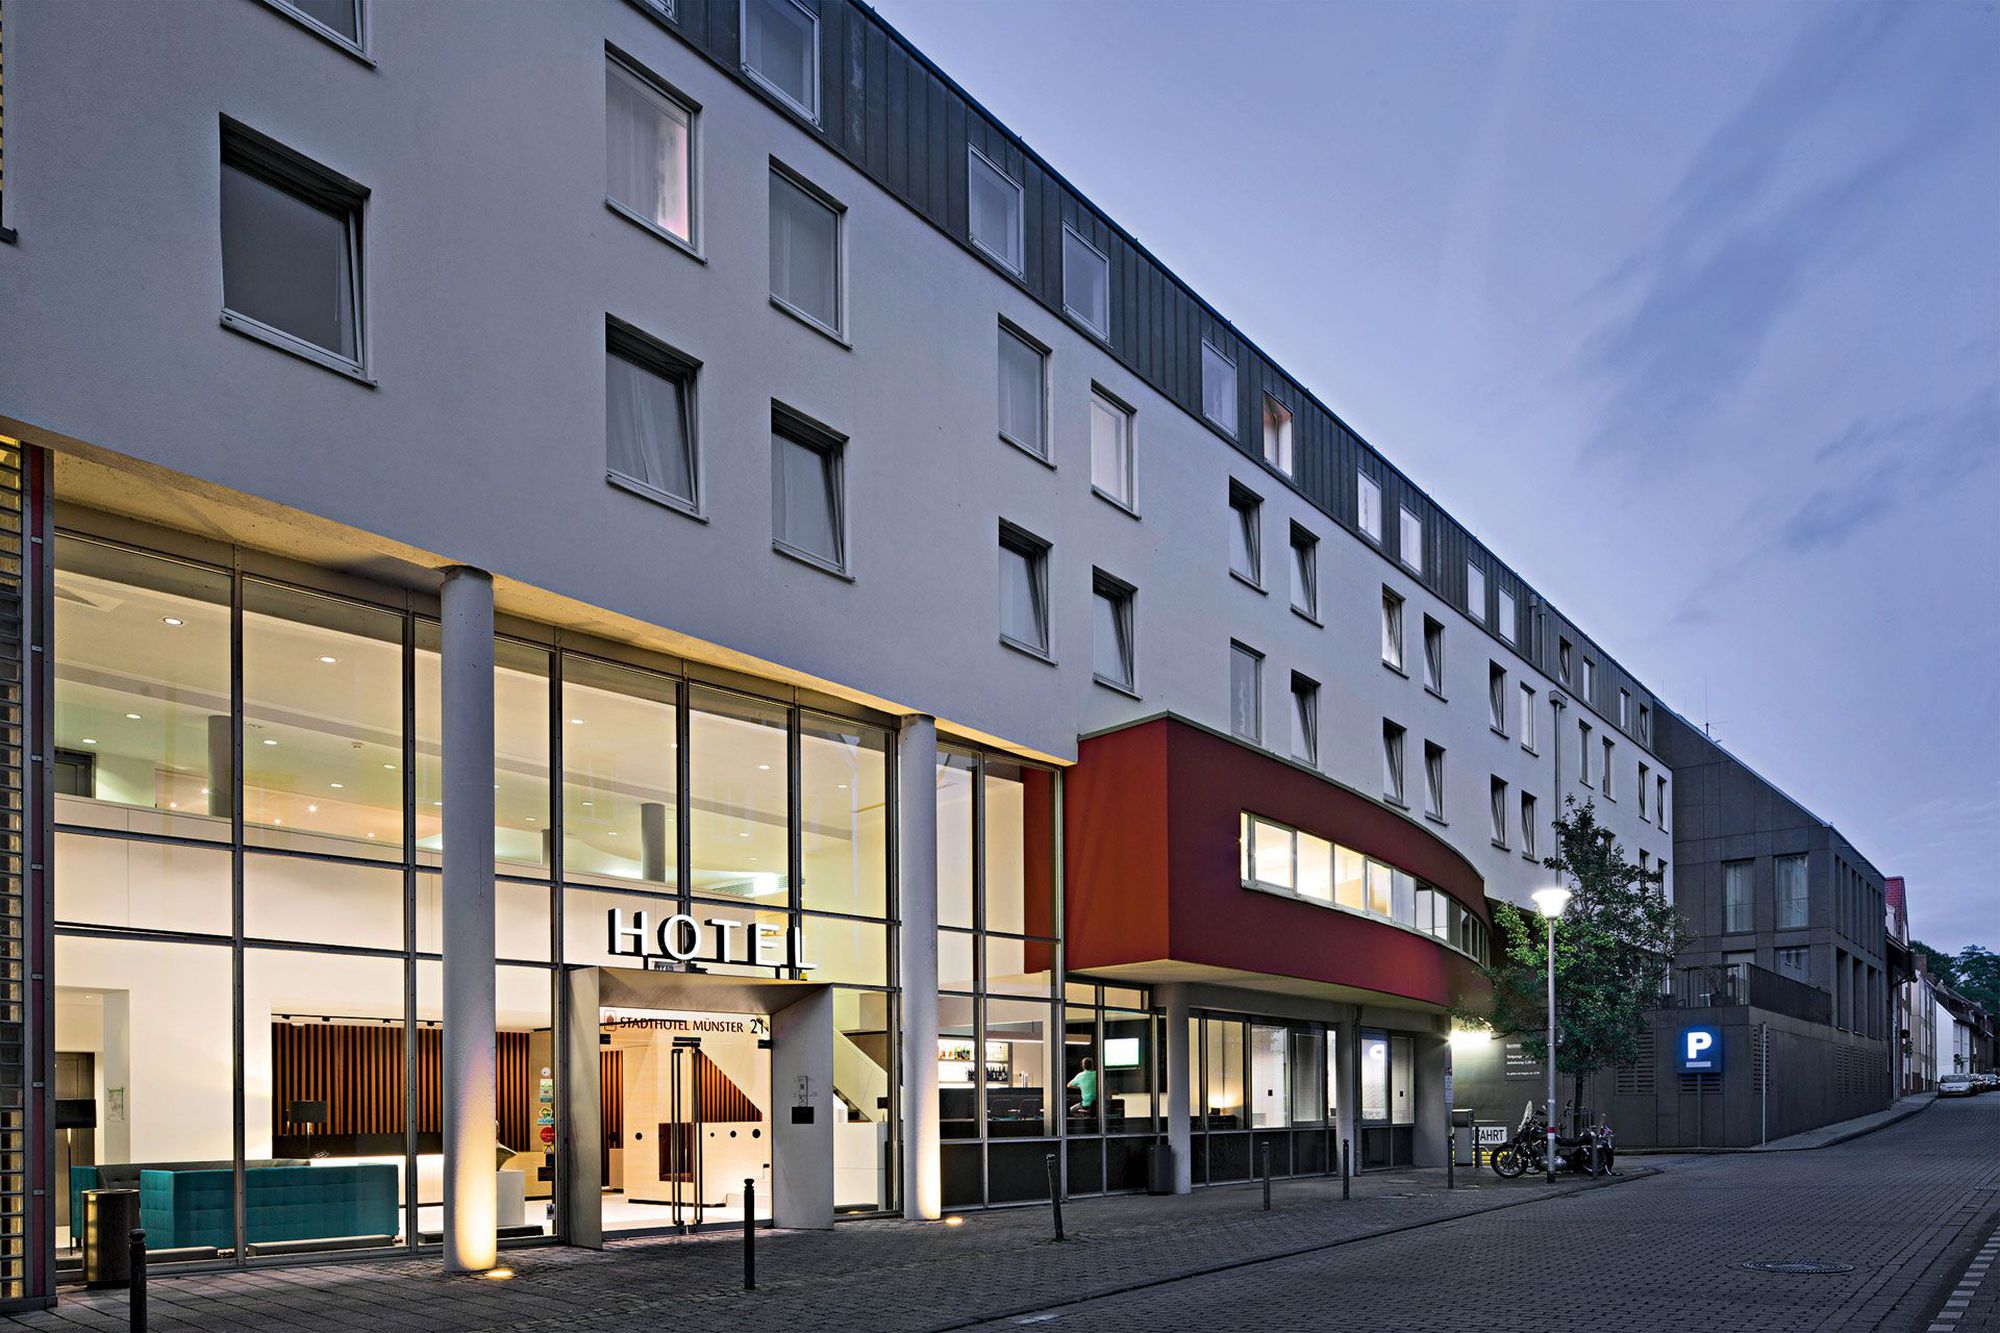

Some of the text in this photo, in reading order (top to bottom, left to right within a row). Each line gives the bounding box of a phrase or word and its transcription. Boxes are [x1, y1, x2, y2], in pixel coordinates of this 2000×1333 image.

[608, 908, 816, 969] HOTEL
[620, 1016, 690, 1031] STADTHOTEL
[692, 1017, 744, 1033] MÜNSTER
[1687, 1031, 1712, 1059] P
[1475, 1129, 1504, 1141] AHRT
